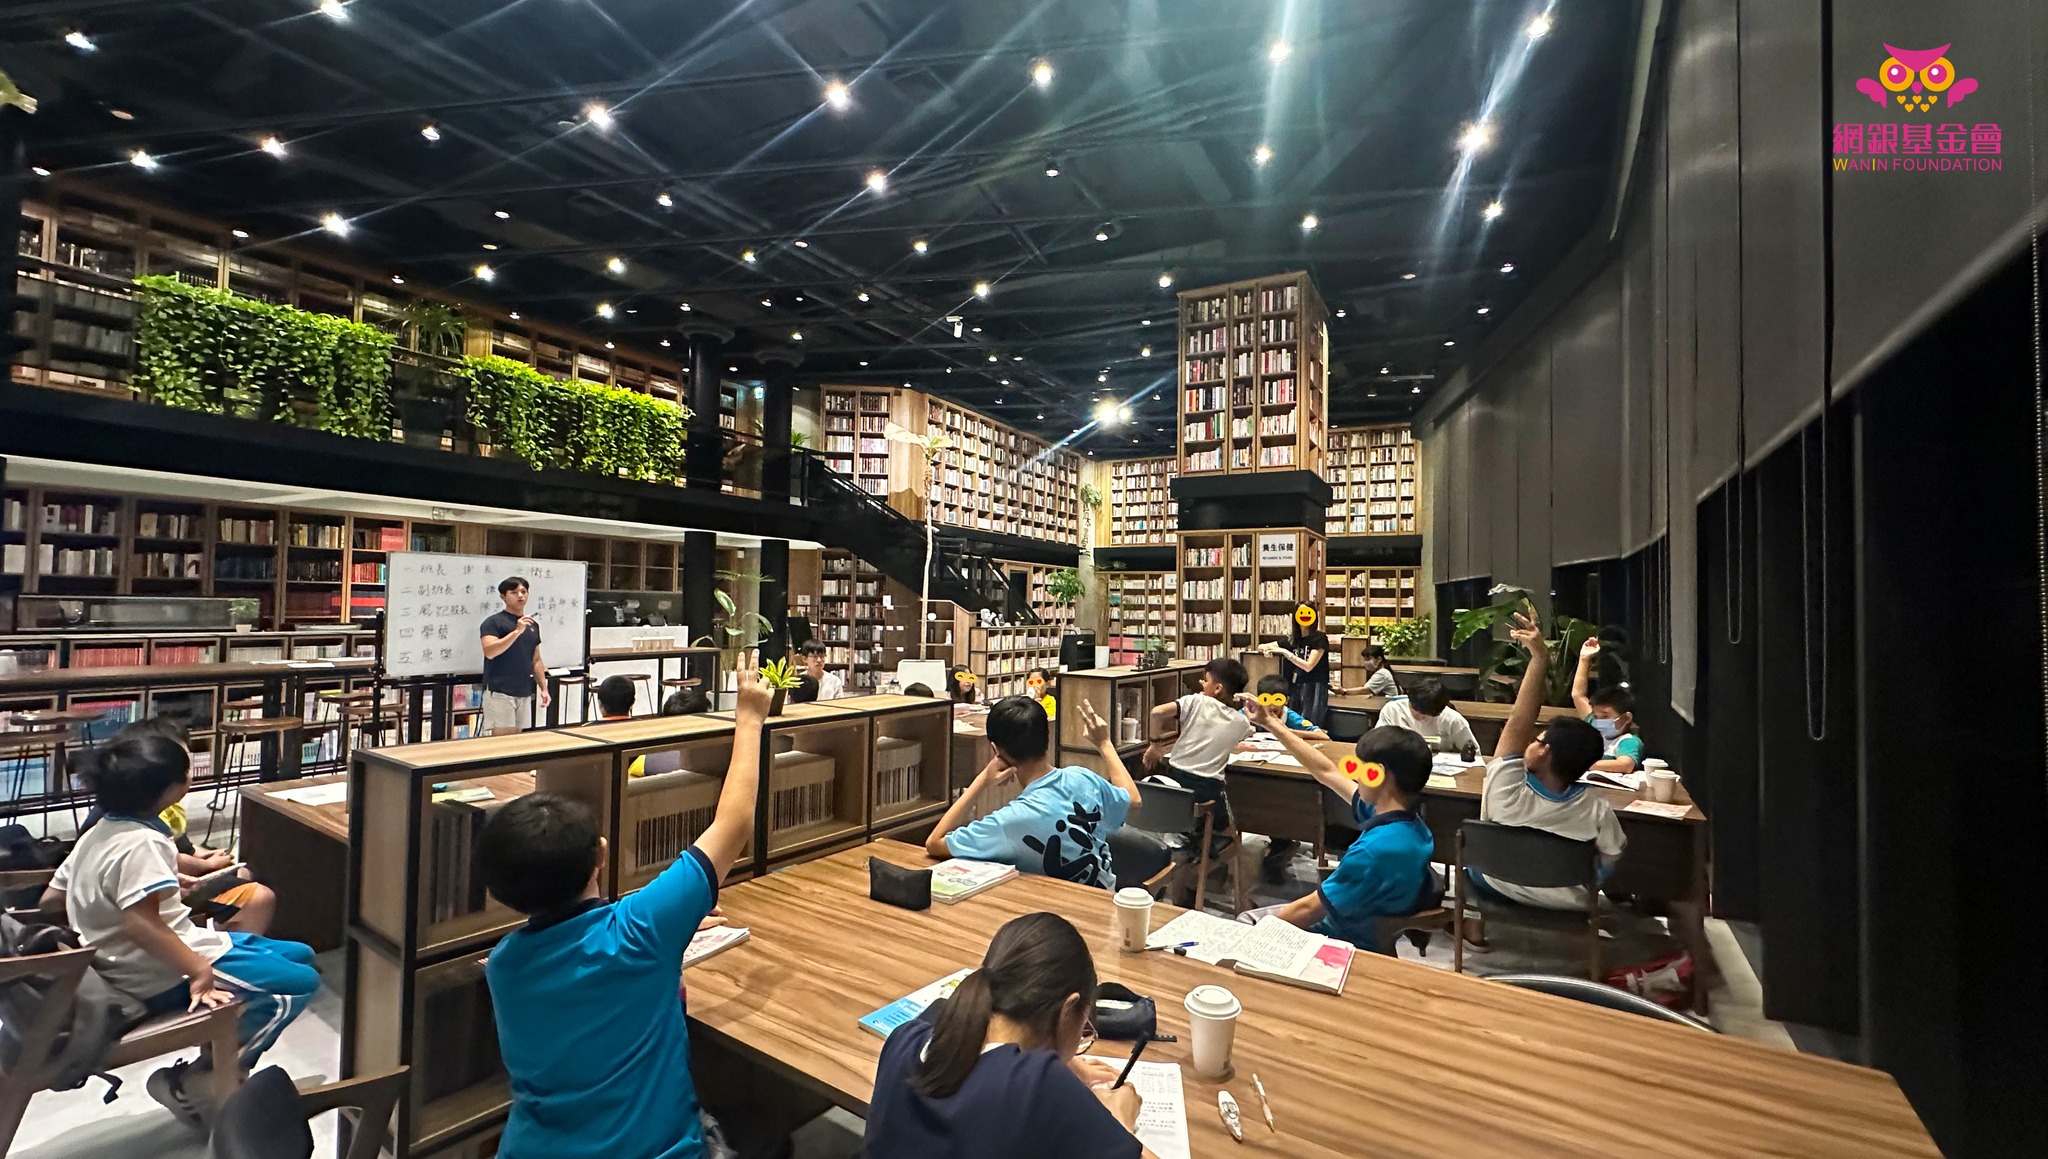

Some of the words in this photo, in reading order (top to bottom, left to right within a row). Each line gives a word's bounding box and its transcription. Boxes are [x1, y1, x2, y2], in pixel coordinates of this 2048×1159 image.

[1262, 542, 1294, 552] 養生保健
[420, 563, 447, 576] 班長
[400, 586, 412, 594] 二
[417, 583, 455, 597] 副班長
[400, 606, 411, 617] 三
[399, 627, 415, 638] 四
[396, 651, 413, 664] 五
